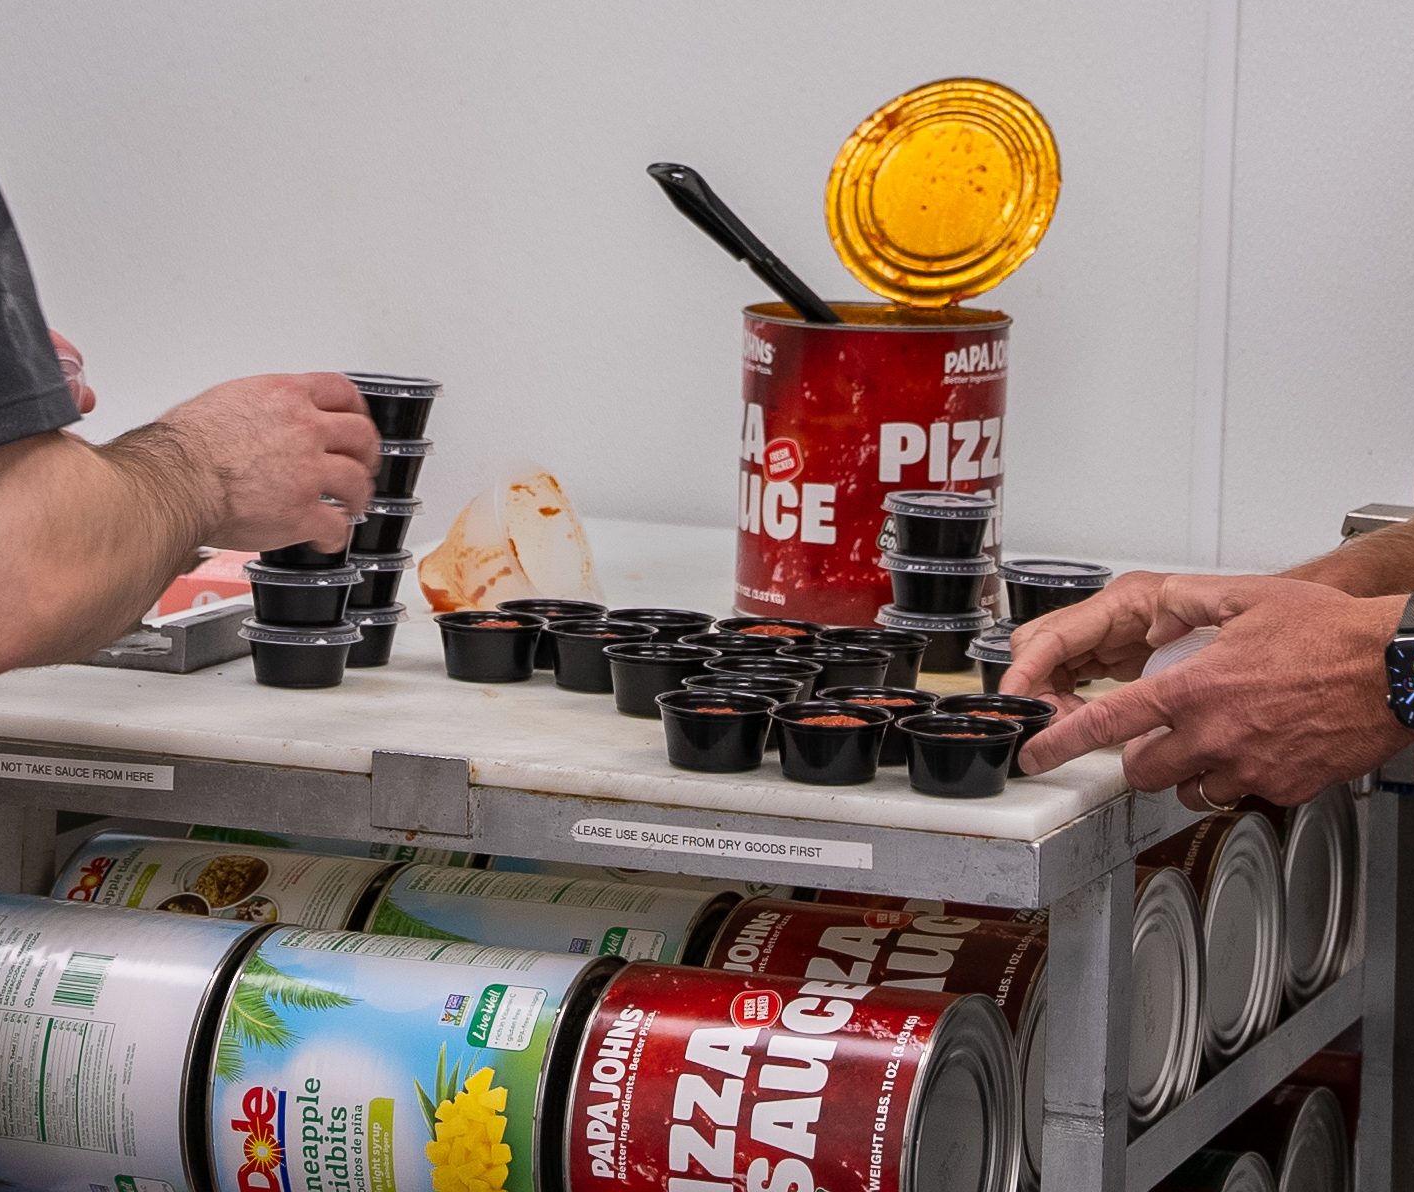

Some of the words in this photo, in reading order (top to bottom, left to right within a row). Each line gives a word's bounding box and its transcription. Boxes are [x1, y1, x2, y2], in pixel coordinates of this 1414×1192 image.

[878, 415, 1003, 482] PIZZ
[739, 472, 836, 544] UCE
[1, 762, 23, 772] NOT
[25, 764, 52, 775] TAKE
[55, 767, 89, 778] SAUCE
[93, 769, 123, 780] FROM
[126, 772, 154, 782] HERE
[577, 825, 612, 838] LEASE
[615, 829, 637, 840] USE
[641, 832, 679, 845] SAUCE
[682, 836, 714, 848] FROM
[719, 839, 741, 851] DRY
[745, 842, 786, 855] GOODS
[790, 846, 822, 858] FIRST
[68, 857, 111, 902] Dole
[723, 911, 780, 973] JOHNS
[639, 1010, 655, 1037] Pizza.
[743, 998, 756, 1020] FRESH
[756, 995, 769, 1021] PACKED
[902, 1015, 920, 1031] KG)
[629, 1036, 646, 1070] Better
[891, 1030, 911, 1057] (3.03
[747, 980, 876, 1192] SAUCE
[882, 1080, 894, 1092] 11
[885, 1059, 901, 1079] OZ.
[352, 1104, 364, 1136] piña
[618, 1072, 636, 1141] Ingredients.
[668, 1026, 761, 1192] IZZA
[874, 1094, 891, 1132] 6LBS.
[231, 1086, 280, 1192] Dole
[296, 1078, 323, 1192] neapple
[325, 1106, 351, 1192] idbits
[351, 1139, 362, 1155] de
[372, 1122, 383, 1152] syrup
[352, 1157, 365, 1192] ocitos
[371, 1153, 383, 1180] light
[617, 1143, 627, 1180] Better
[869, 1133, 884, 1192] WEIGHT
